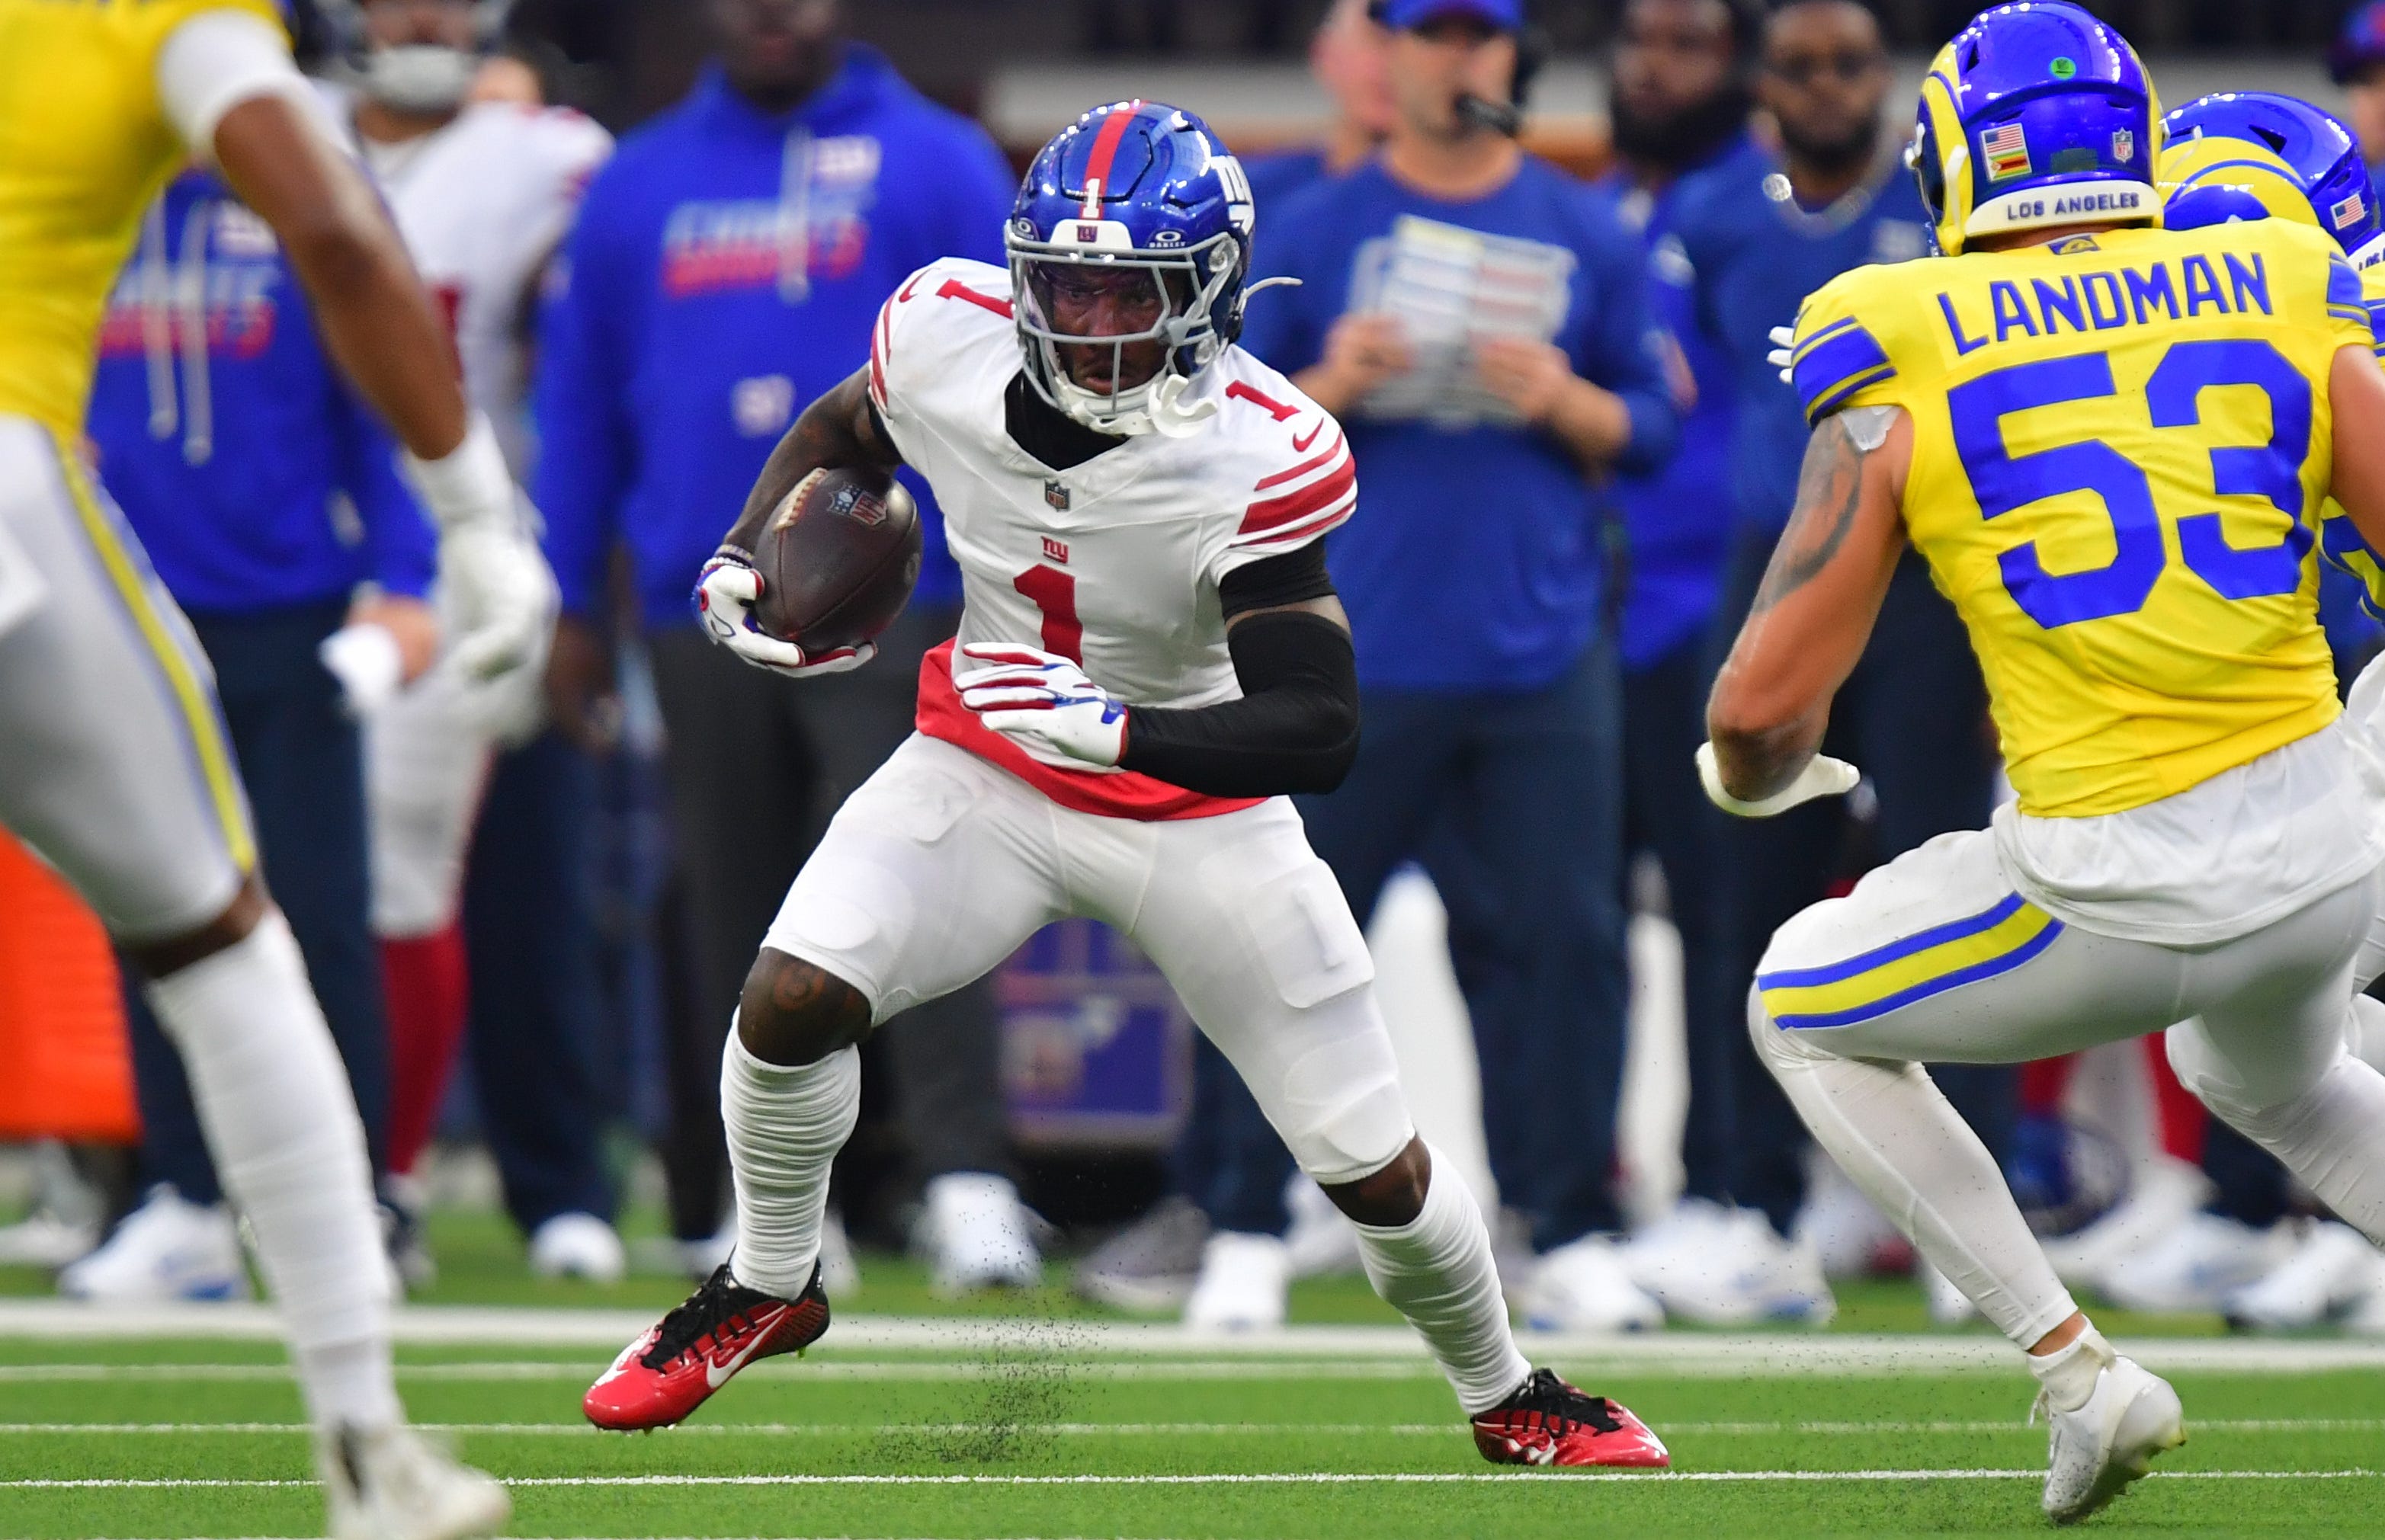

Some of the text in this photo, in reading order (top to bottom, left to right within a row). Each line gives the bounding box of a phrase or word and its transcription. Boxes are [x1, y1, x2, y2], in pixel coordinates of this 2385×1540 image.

[1082, 178, 1101, 218] 1
[2008, 192, 2140, 220] LOS ANGELES
[935, 278, 1014, 320] 1
[1937, 252, 2274, 356] LANDMAN
[1225, 379, 1302, 422] 1
[1947, 338, 2315, 629] 53
[1013, 563, 1084, 669] 1
